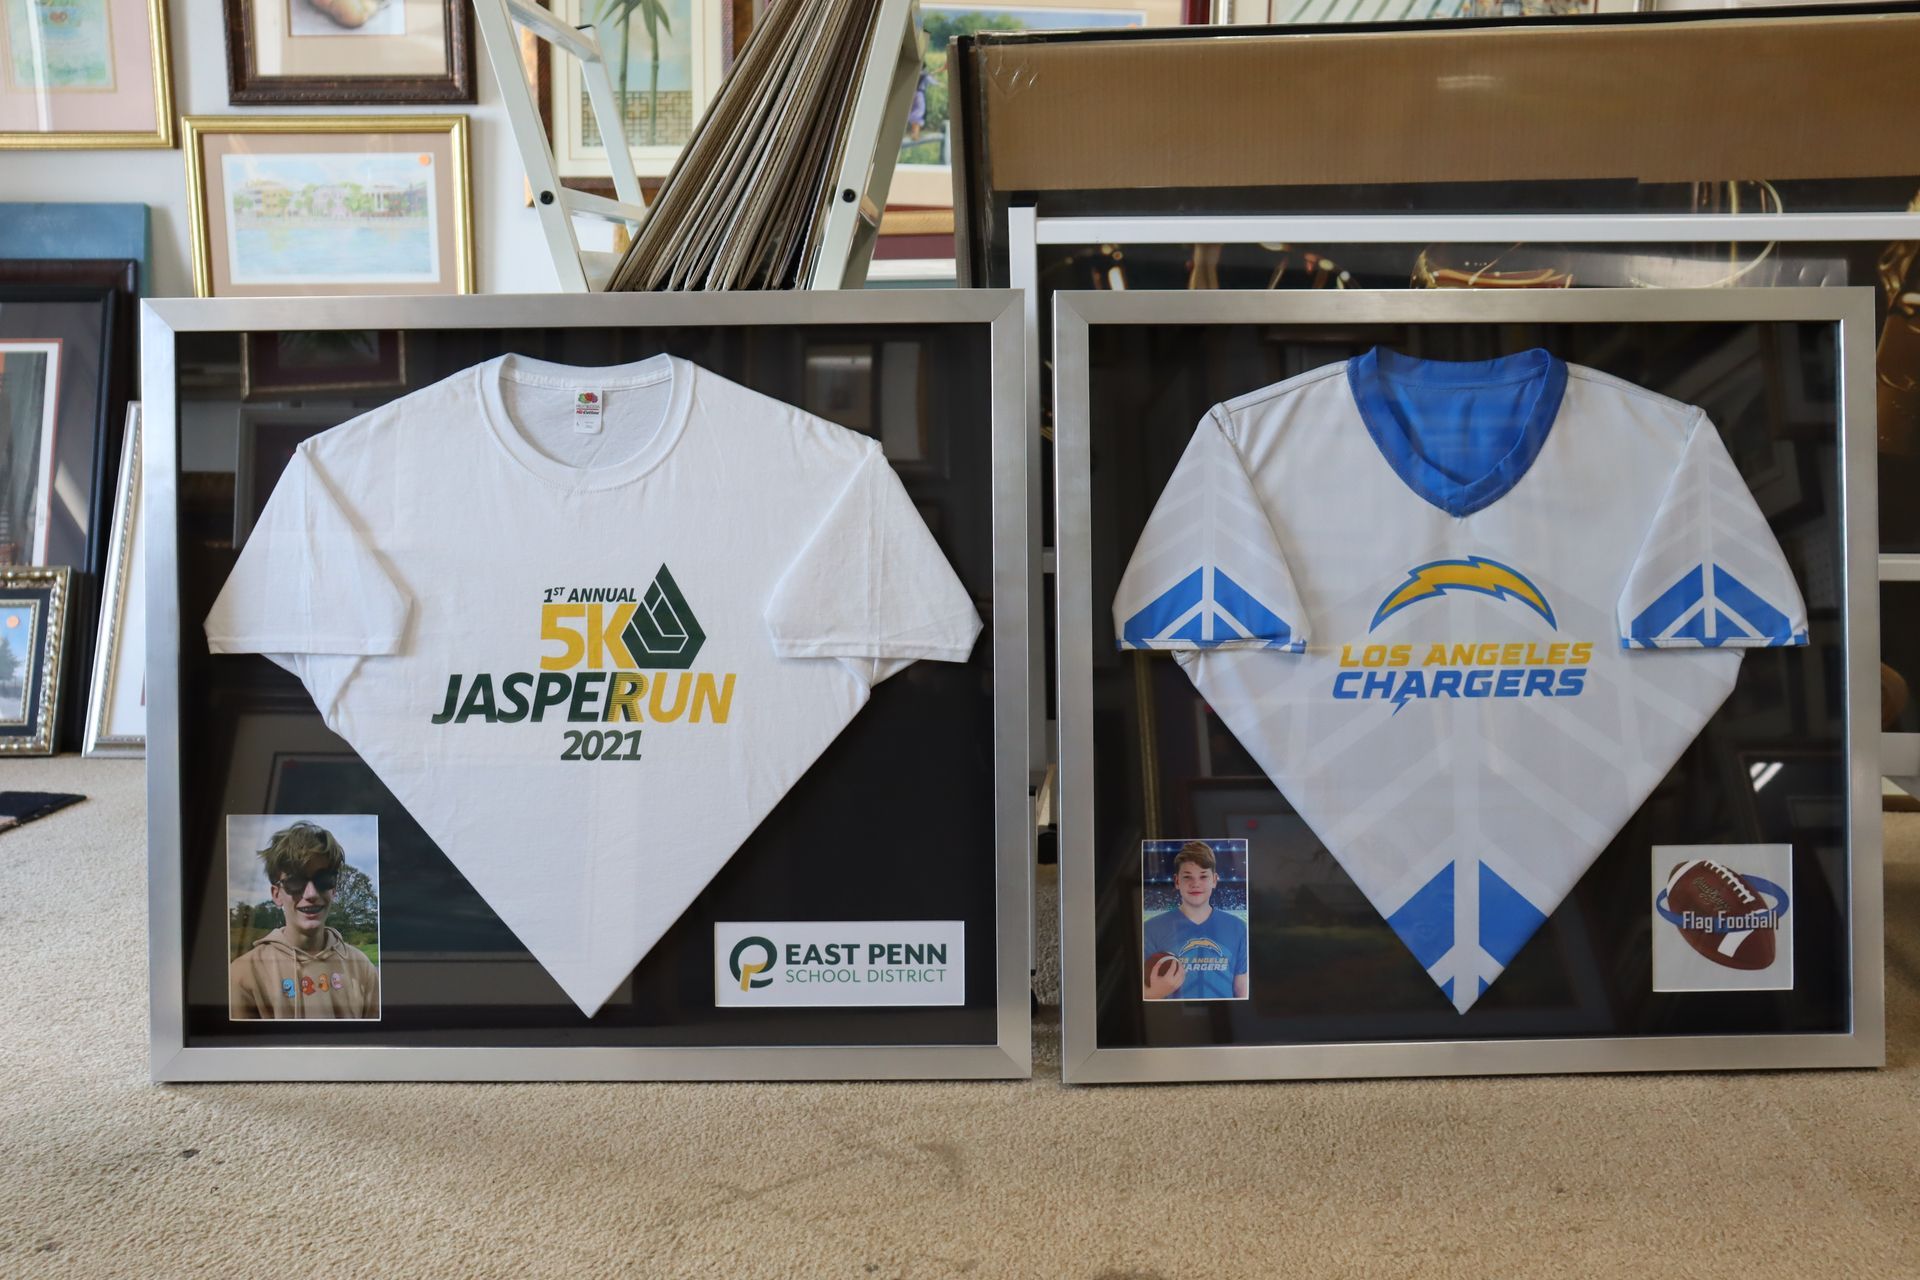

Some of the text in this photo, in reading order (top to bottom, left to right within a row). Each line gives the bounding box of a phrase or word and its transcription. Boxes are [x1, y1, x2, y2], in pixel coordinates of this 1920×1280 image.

[567, 587, 638, 603] ANNUAL
[539, 603, 639, 672] 5K
[1339, 642, 1594, 668] LOS ANGELES
[1332, 668, 1588, 717] CHARGERS
[560, 729, 643, 761] 2021
[1682, 910, 1778, 934] Flag Football
[785, 943, 948, 966] EAST PENN
[785, 968, 948, 984] SCHOOL DISTRICT
[1184, 963, 1228, 972] ARGERS
